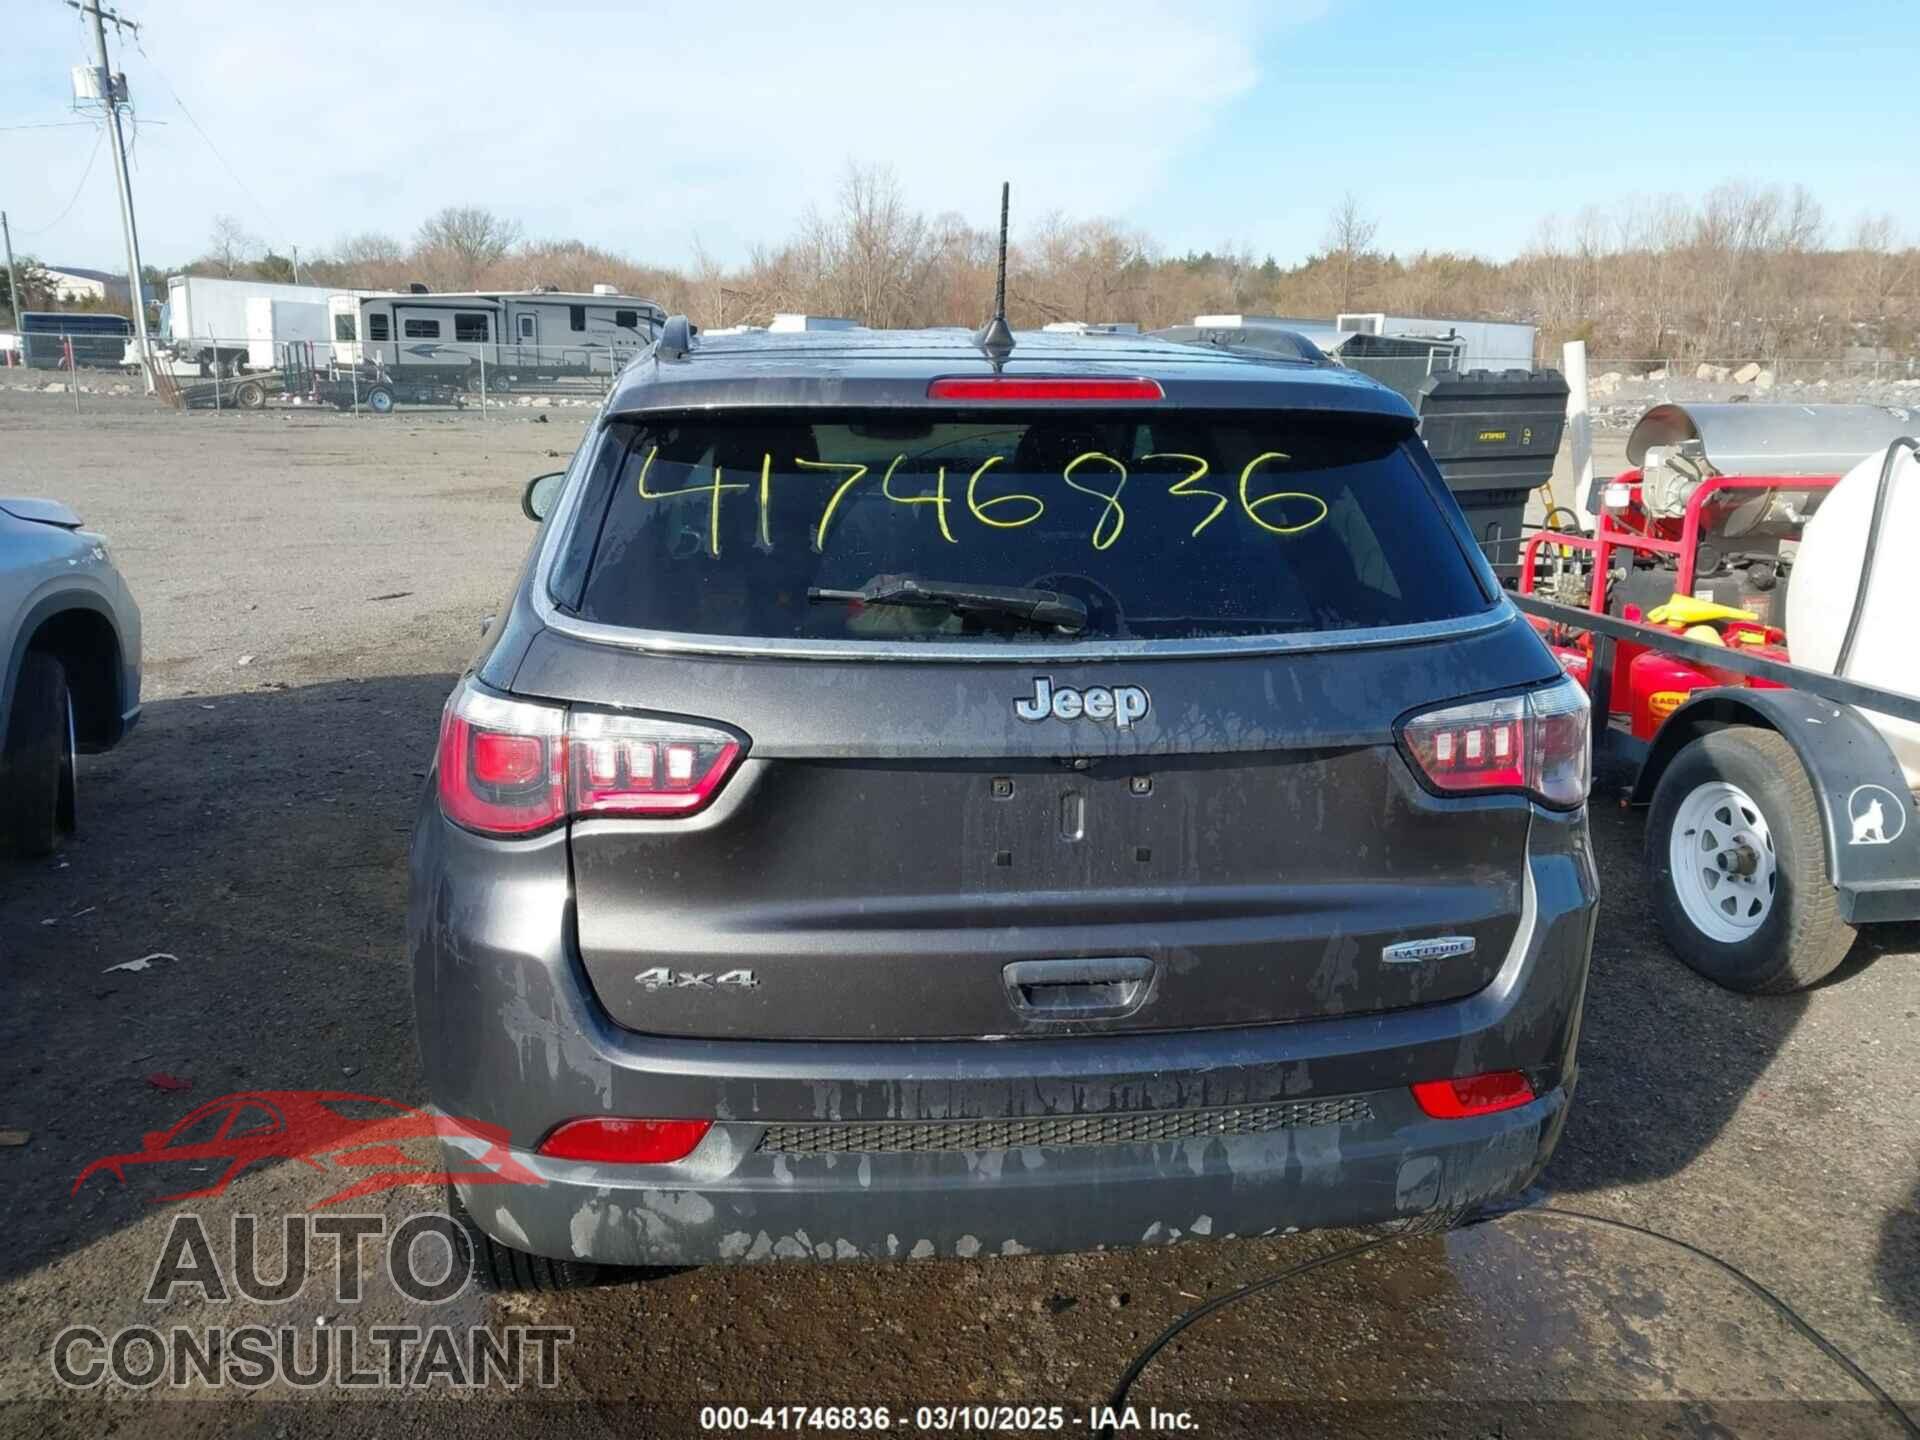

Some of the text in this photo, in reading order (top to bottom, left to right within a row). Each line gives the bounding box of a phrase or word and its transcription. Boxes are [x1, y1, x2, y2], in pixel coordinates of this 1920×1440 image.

[638, 445, 1328, 558] 41746836
[1014, 676, 1150, 728] Jeep
[1393, 943, 1467, 957] LATITUDE
[634, 967, 761, 992] 4x4
